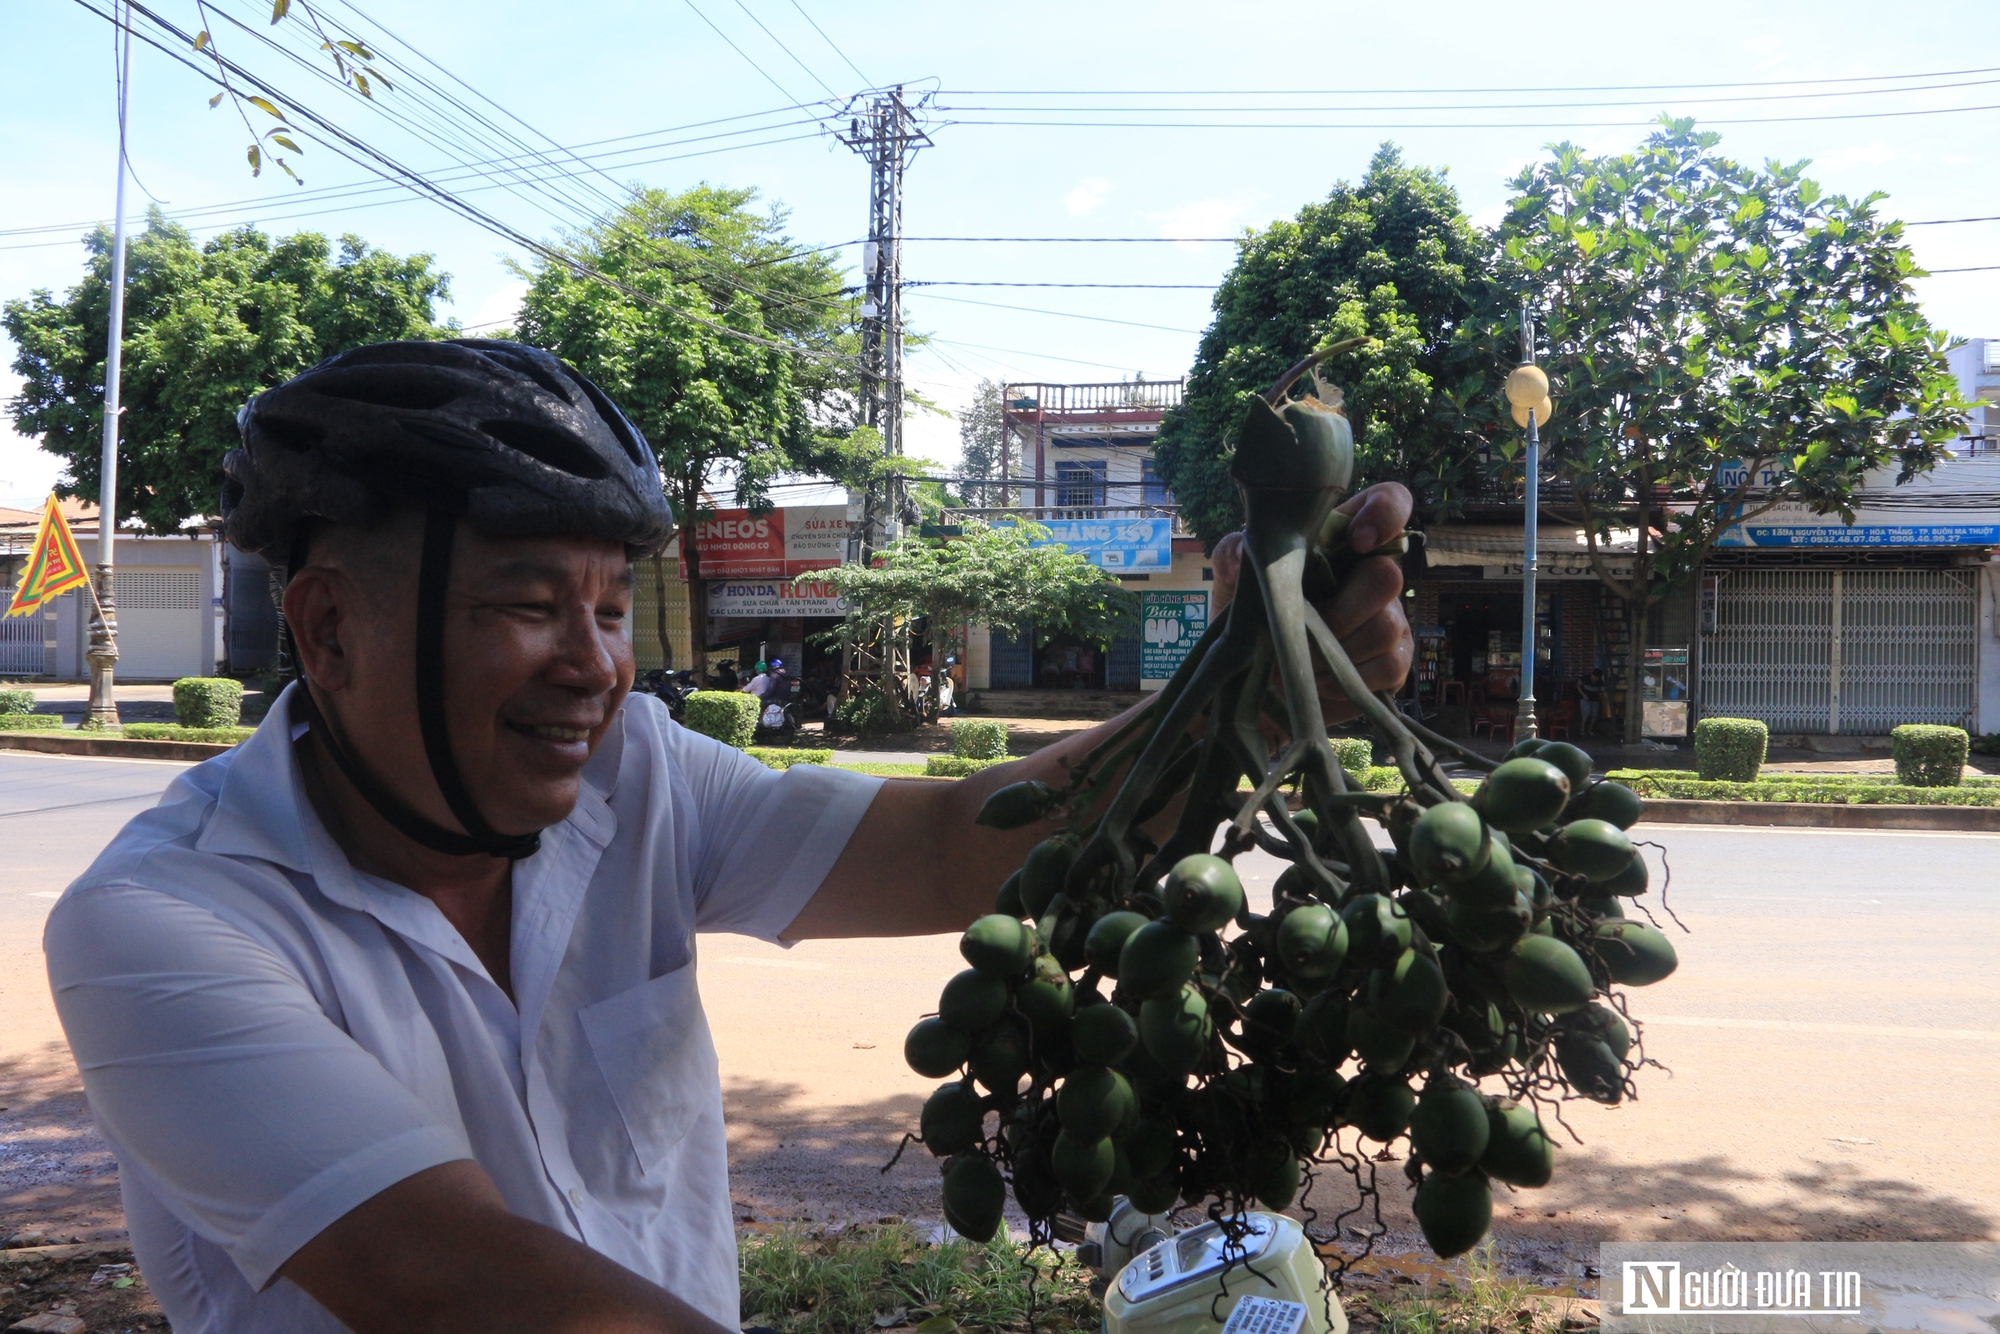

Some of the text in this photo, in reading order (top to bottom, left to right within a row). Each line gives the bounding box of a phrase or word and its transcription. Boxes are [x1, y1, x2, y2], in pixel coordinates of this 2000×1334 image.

[805, 516, 826, 530] SỬA
[829, 520, 843, 529] XE
[695, 519, 770, 540] ENEOS
[1114, 524, 1154, 543] 159
[1932, 527, 1953, 535] BUÔN
[1968, 527, 1994, 536] THUỘT
[726, 585, 775, 597] HONDA
[774, 606, 791, 615] MÁY
[1145, 606, 1183, 618] Bán:
